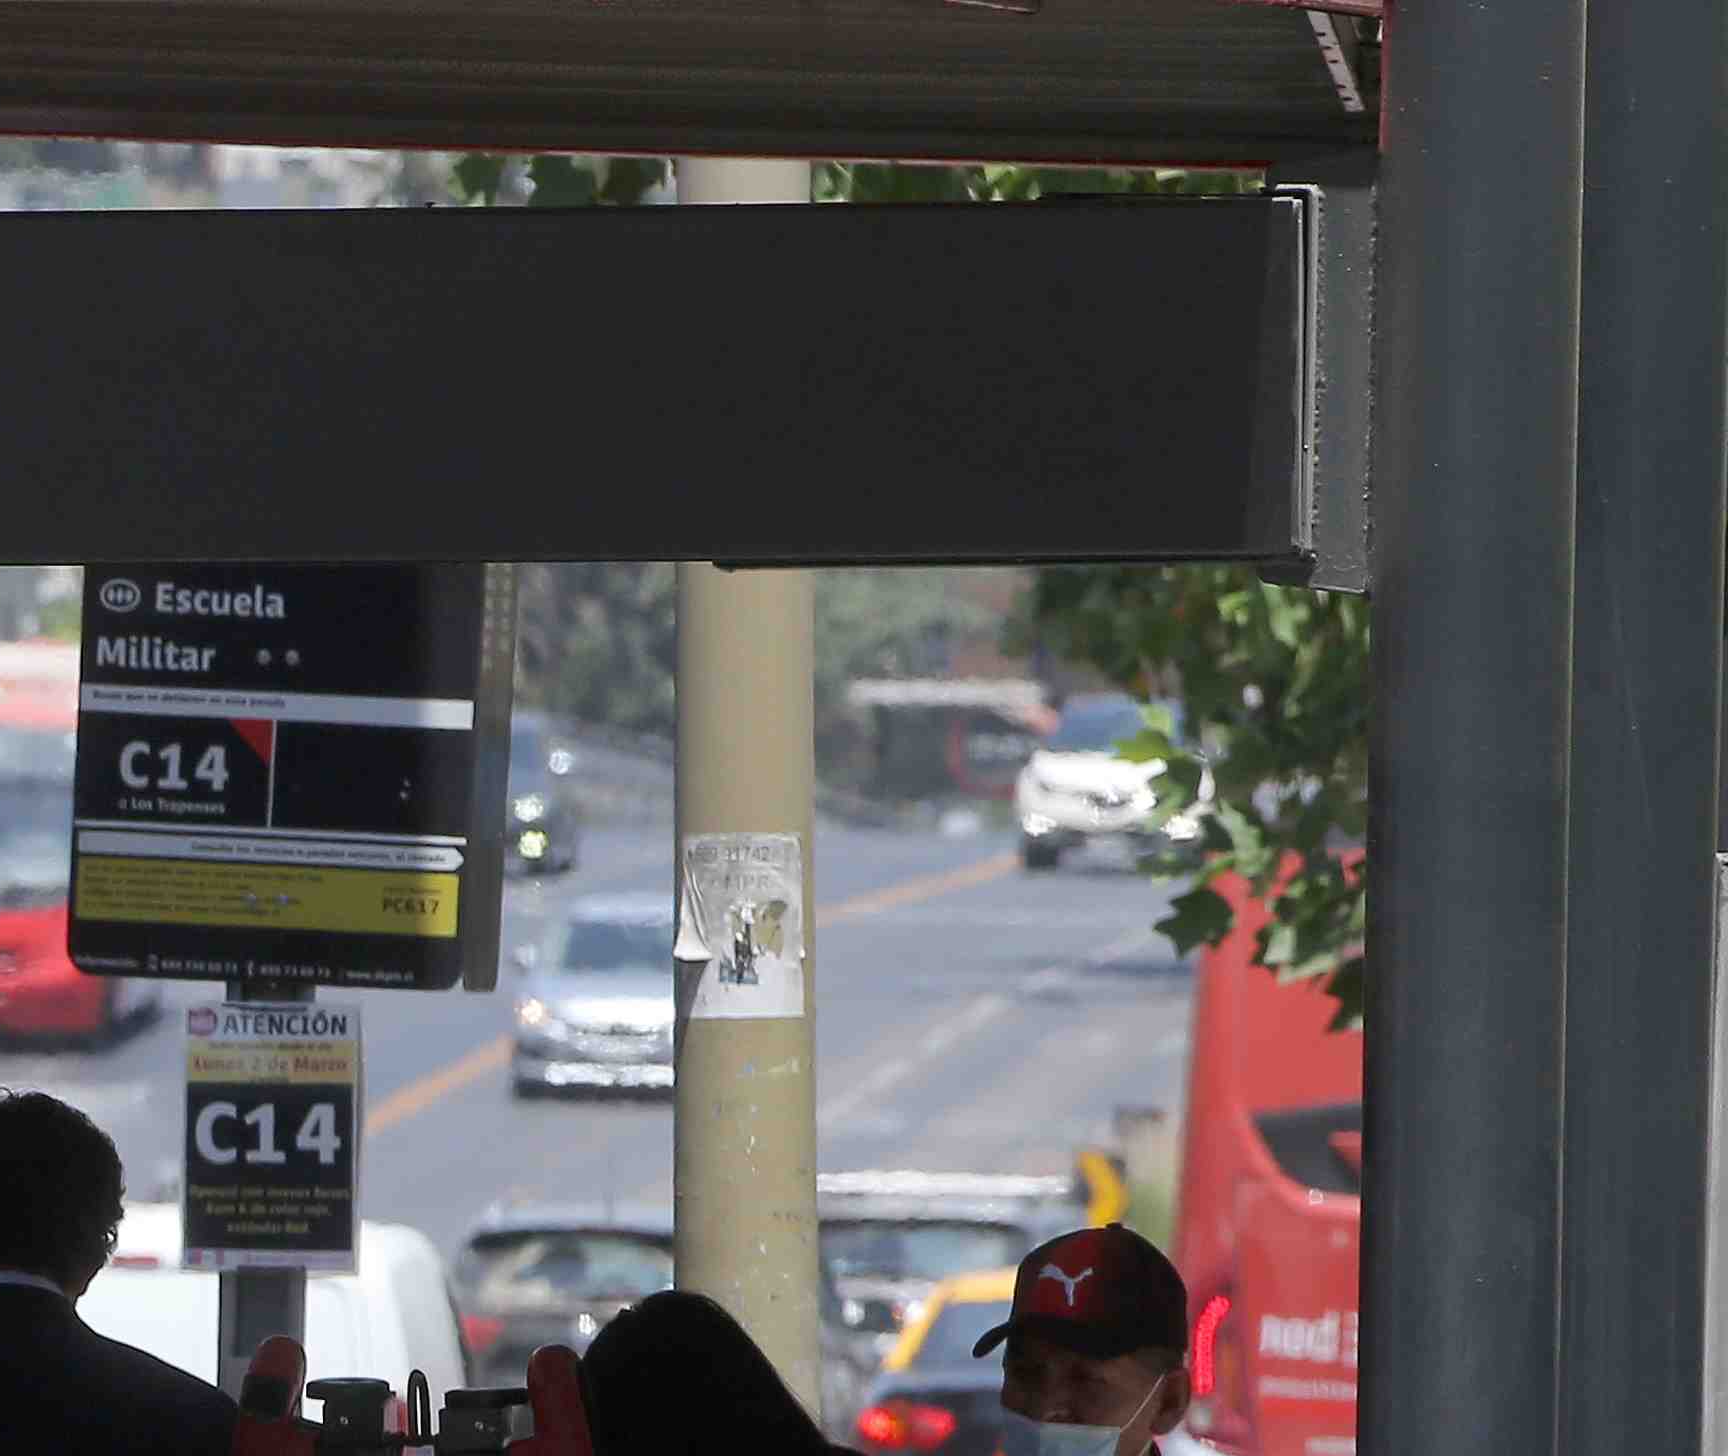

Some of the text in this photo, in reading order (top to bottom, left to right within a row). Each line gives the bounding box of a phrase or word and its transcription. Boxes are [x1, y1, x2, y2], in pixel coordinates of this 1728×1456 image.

[155, 581, 287, 620] Escuela
[96, 636, 217, 673] Militar
[119, 740, 230, 793] C14
[223, 1009, 347, 1036] ATENCIÓN
[194, 1101, 341, 1166] C14
